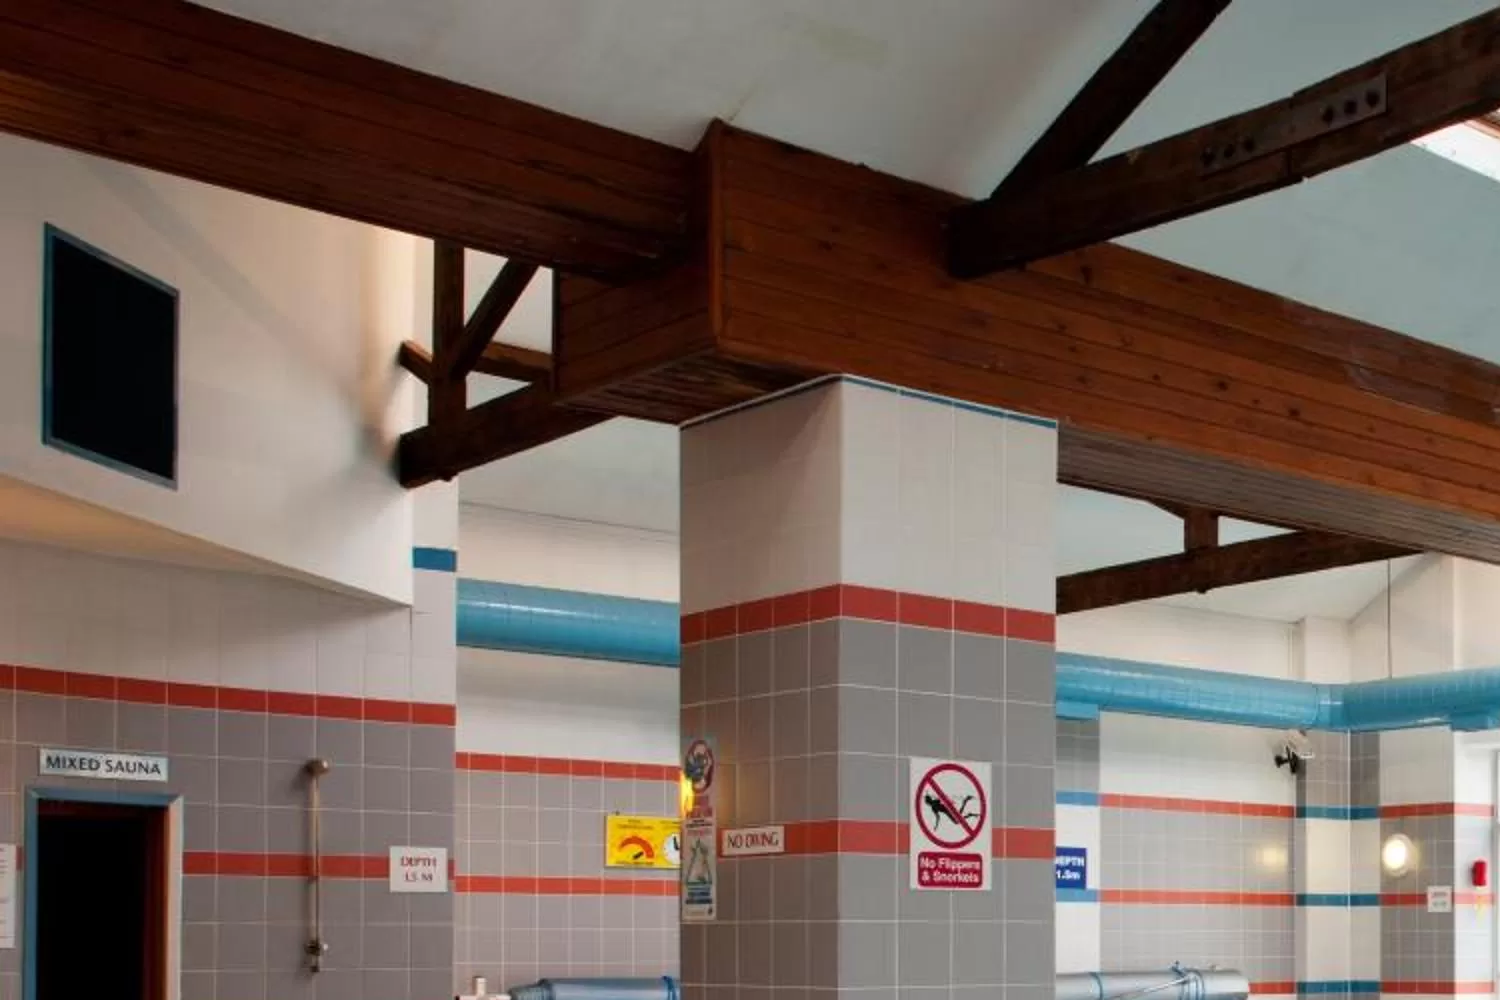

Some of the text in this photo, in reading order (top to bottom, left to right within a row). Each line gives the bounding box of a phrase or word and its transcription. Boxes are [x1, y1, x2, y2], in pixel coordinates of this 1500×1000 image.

[46, 755, 161, 775] MIXED SAUNA
[727, 831, 779, 849] NO DIVING
[401, 856, 437, 867] DEPTH
[920, 856, 980, 872] No Flippers
[921, 870, 930, 882] &
